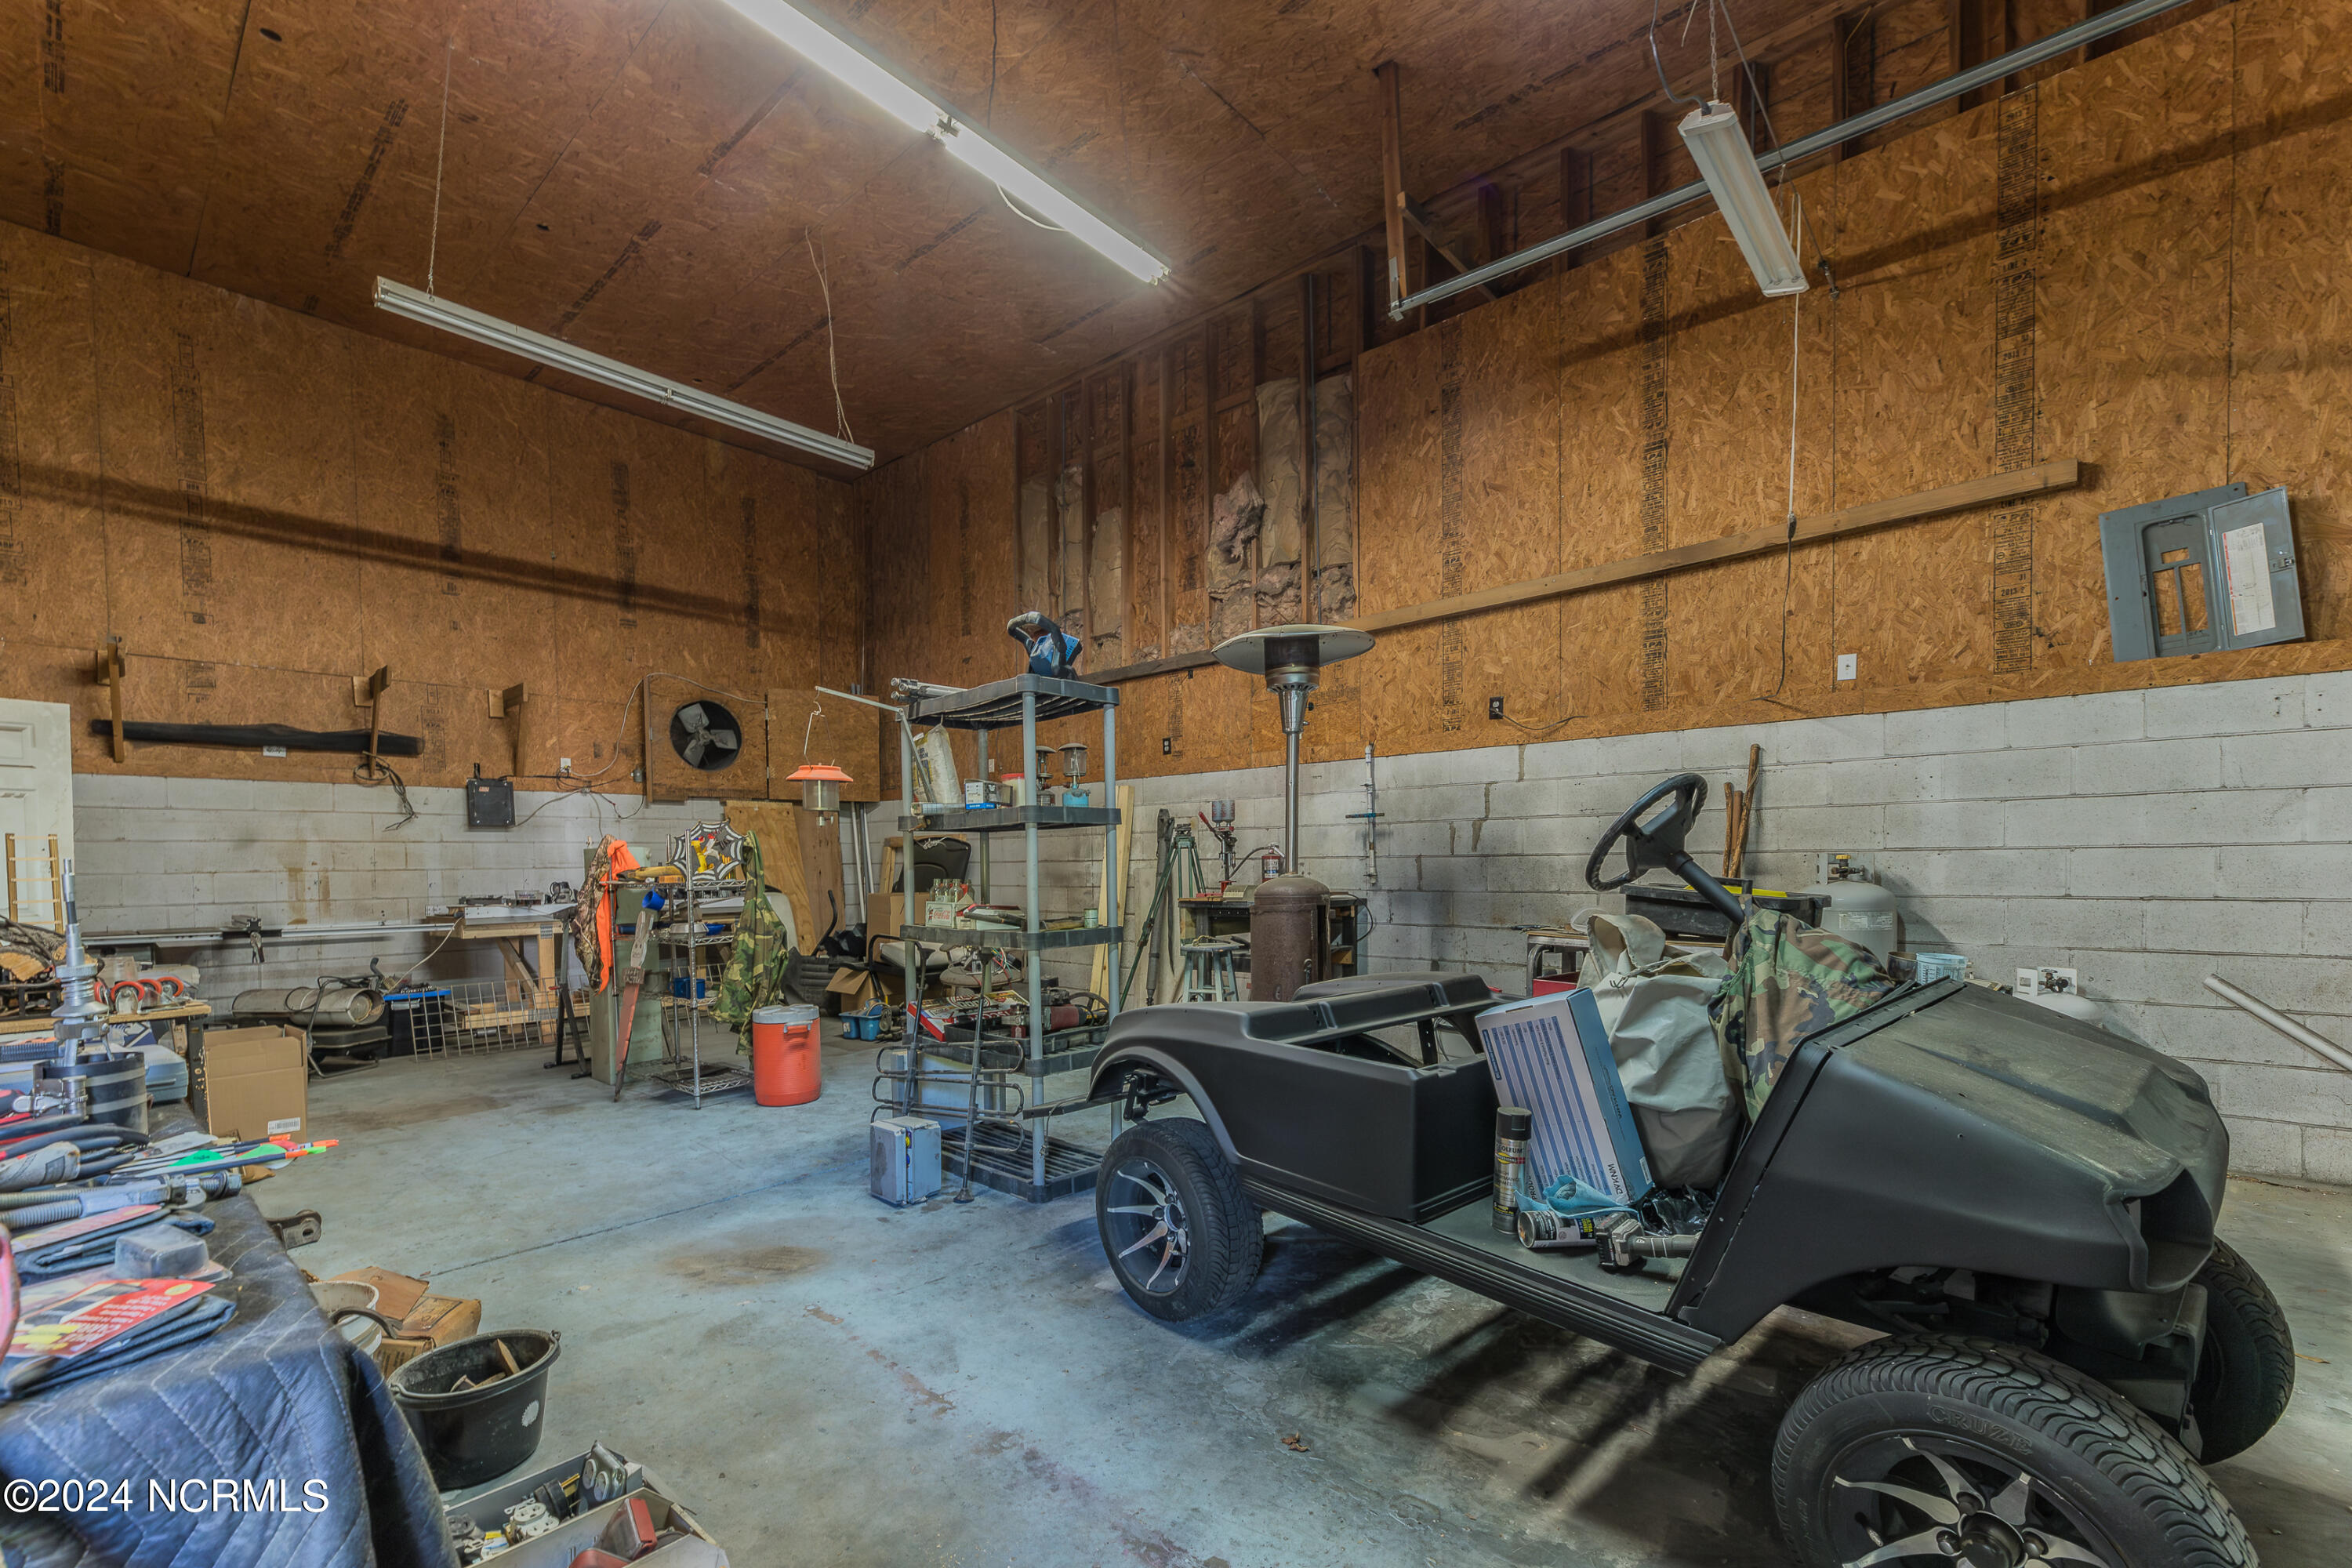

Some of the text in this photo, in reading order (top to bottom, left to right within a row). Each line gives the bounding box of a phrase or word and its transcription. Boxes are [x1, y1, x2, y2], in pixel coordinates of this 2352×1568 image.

[1529, 1174, 1537, 1200] PRODU
[1606, 1163, 1625, 1196] DYKNM
[1928, 1406, 2033, 1455] CRUZE
